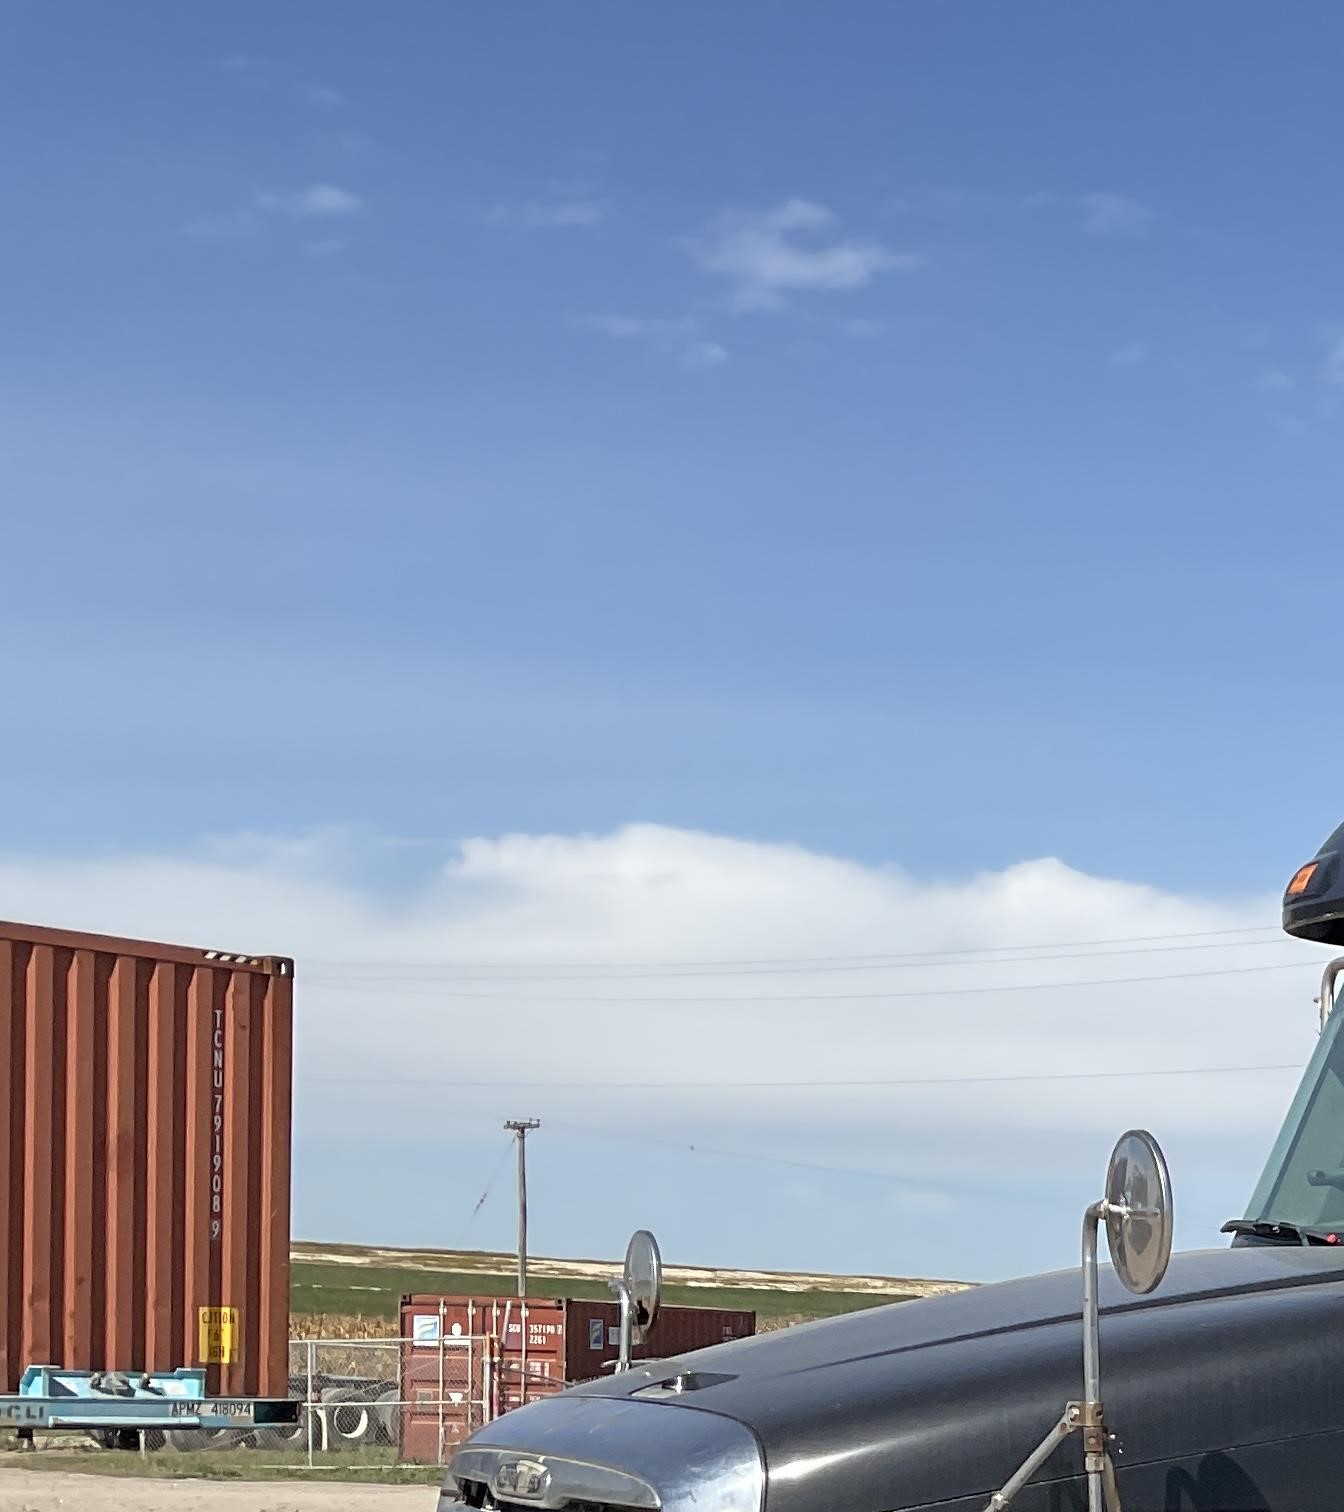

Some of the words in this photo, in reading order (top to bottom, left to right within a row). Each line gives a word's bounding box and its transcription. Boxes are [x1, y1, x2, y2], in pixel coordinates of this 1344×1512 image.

[213, 1009, 223, 1088] TCNU
[212, 1095, 222, 1213] 791908
[211, 1220, 220, 1238] 9
[0, 1405, 45, 1419] CLI
[211, 1401, 251, 1416] 418094
